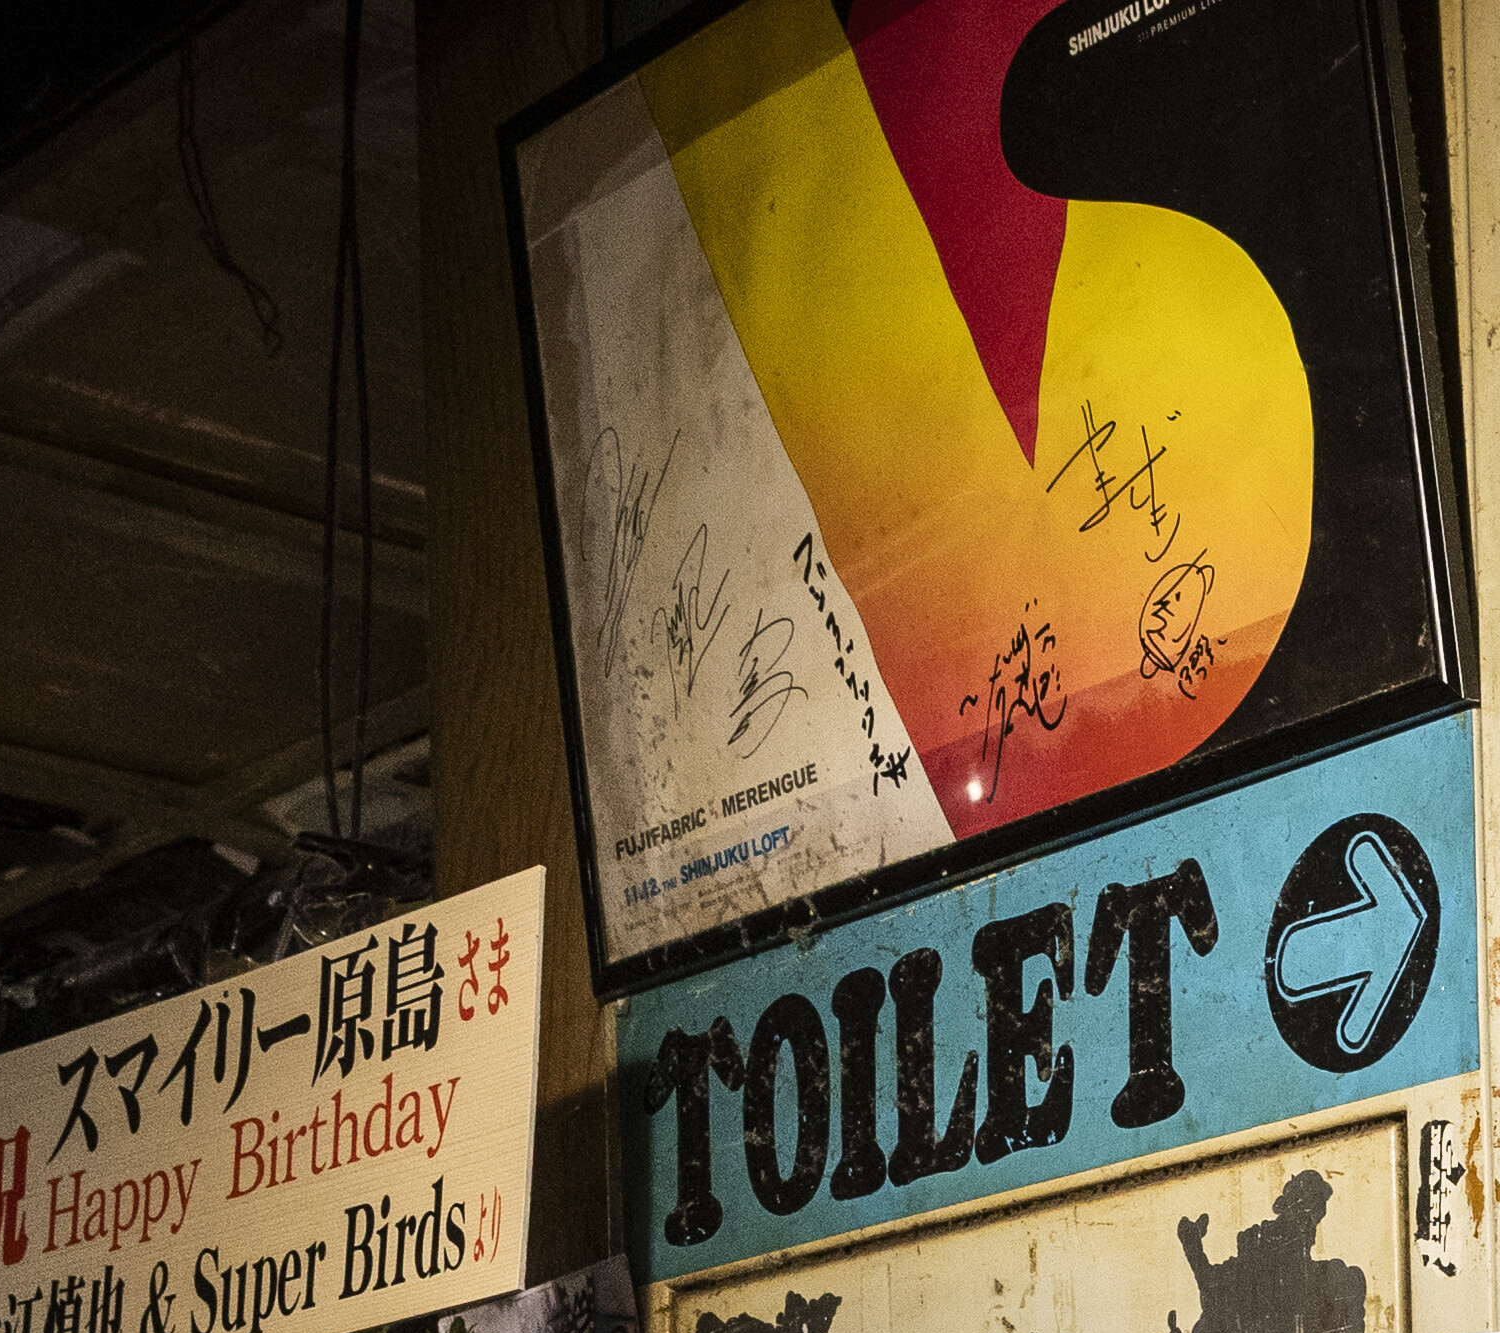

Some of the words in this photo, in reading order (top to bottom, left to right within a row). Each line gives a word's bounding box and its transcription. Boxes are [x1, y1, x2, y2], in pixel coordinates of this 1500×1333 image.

[1069, 1, 1141, 56] SHINJUKU
[615, 807, 706, 861] FUJIFABRIC
[721, 763, 818, 819] MERENGUE
[680, 845, 750, 886] SHINJUKU
[752, 825, 791, 860] LOFT
[47, 921, 445, 1165] スマイリー原島
[455, 916, 511, 1023] さま
[642, 856, 1219, 1249] TOILET
[41, 1156, 202, 1255] Happy
[225, 1071, 462, 1201] Birthday
[338, 1174, 467, 1301] Birds
[472, 1184, 503, 1265] より
